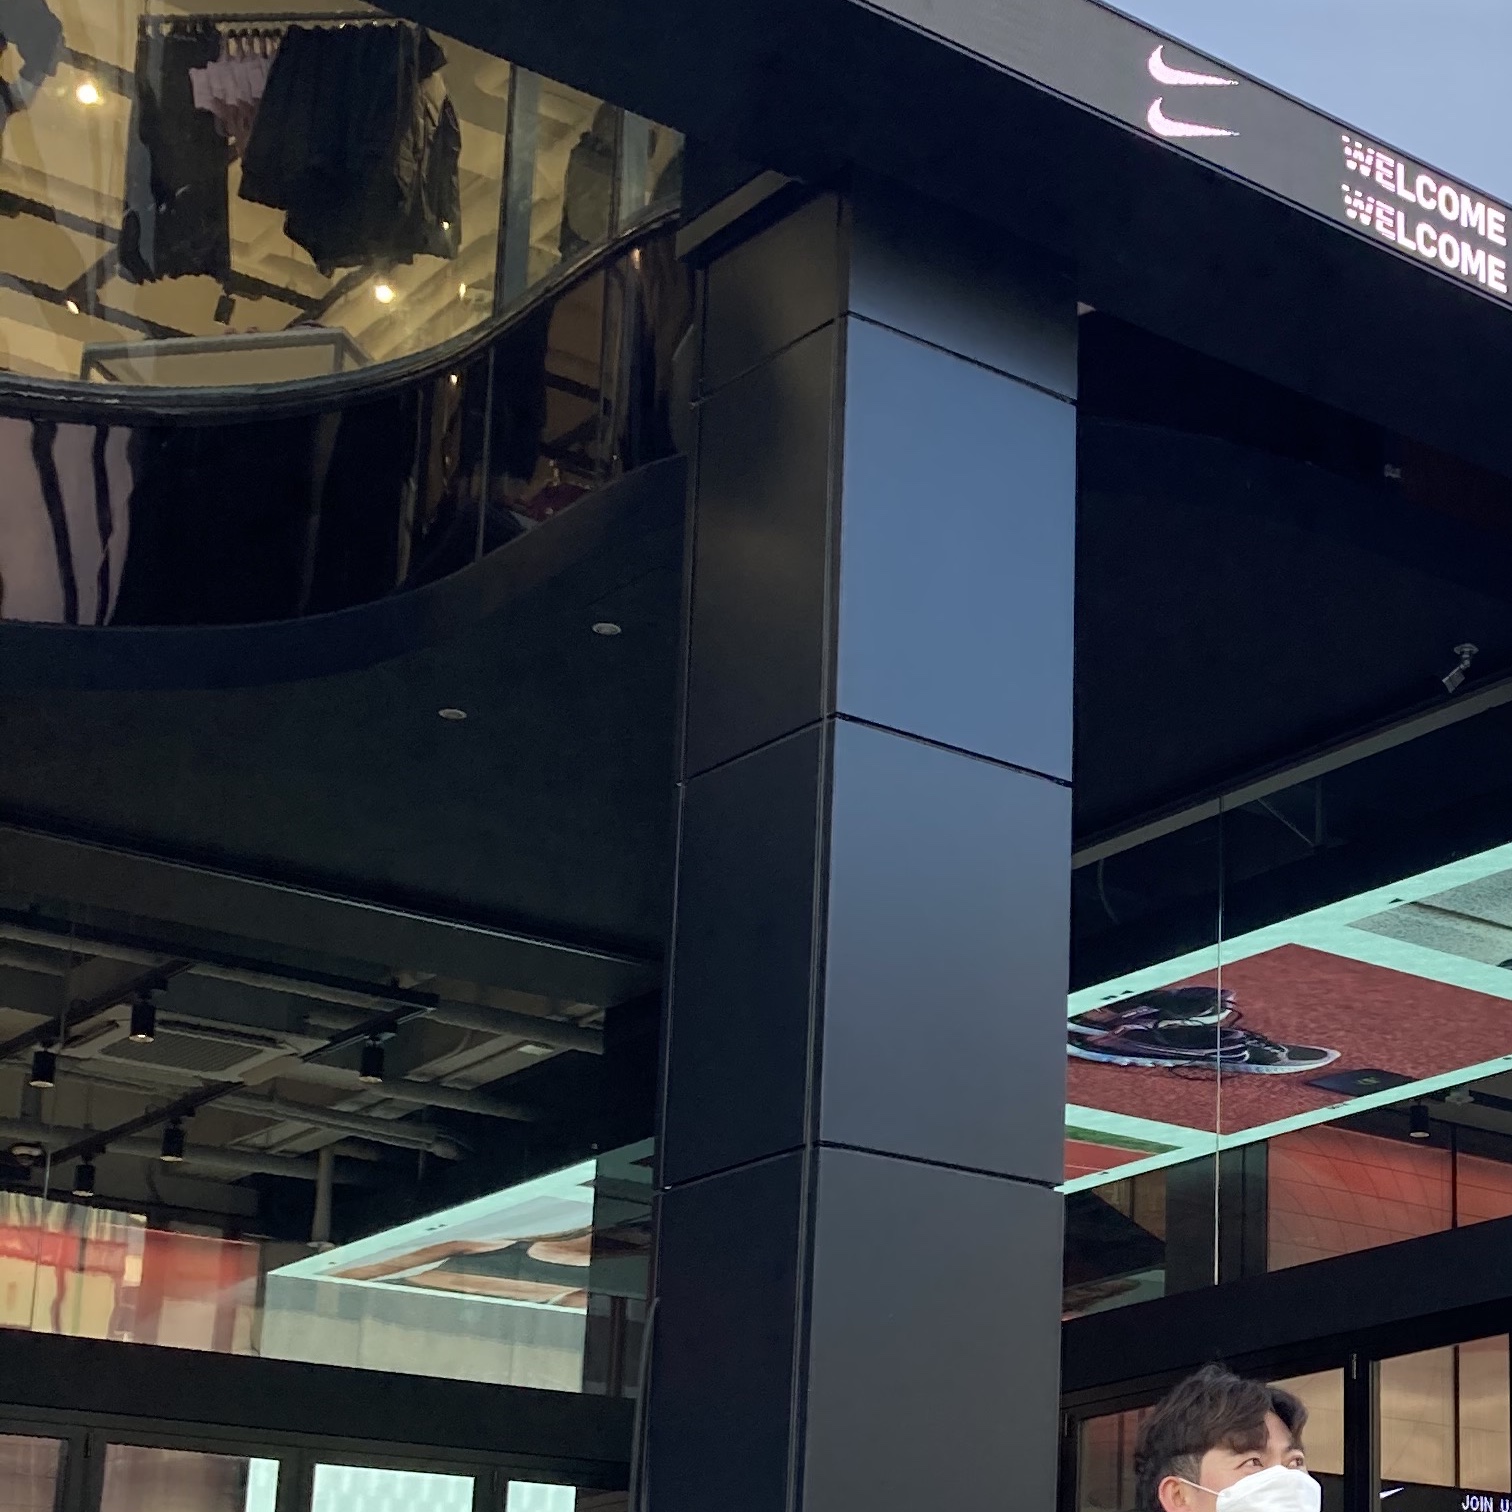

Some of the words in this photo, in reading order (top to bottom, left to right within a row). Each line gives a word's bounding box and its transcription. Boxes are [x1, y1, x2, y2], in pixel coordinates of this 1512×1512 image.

[1342, 135, 1507, 247] WELCOME
[1342, 183, 1507, 294] WELCOME
[1461, 1495, 1494, 1512] JOIN
